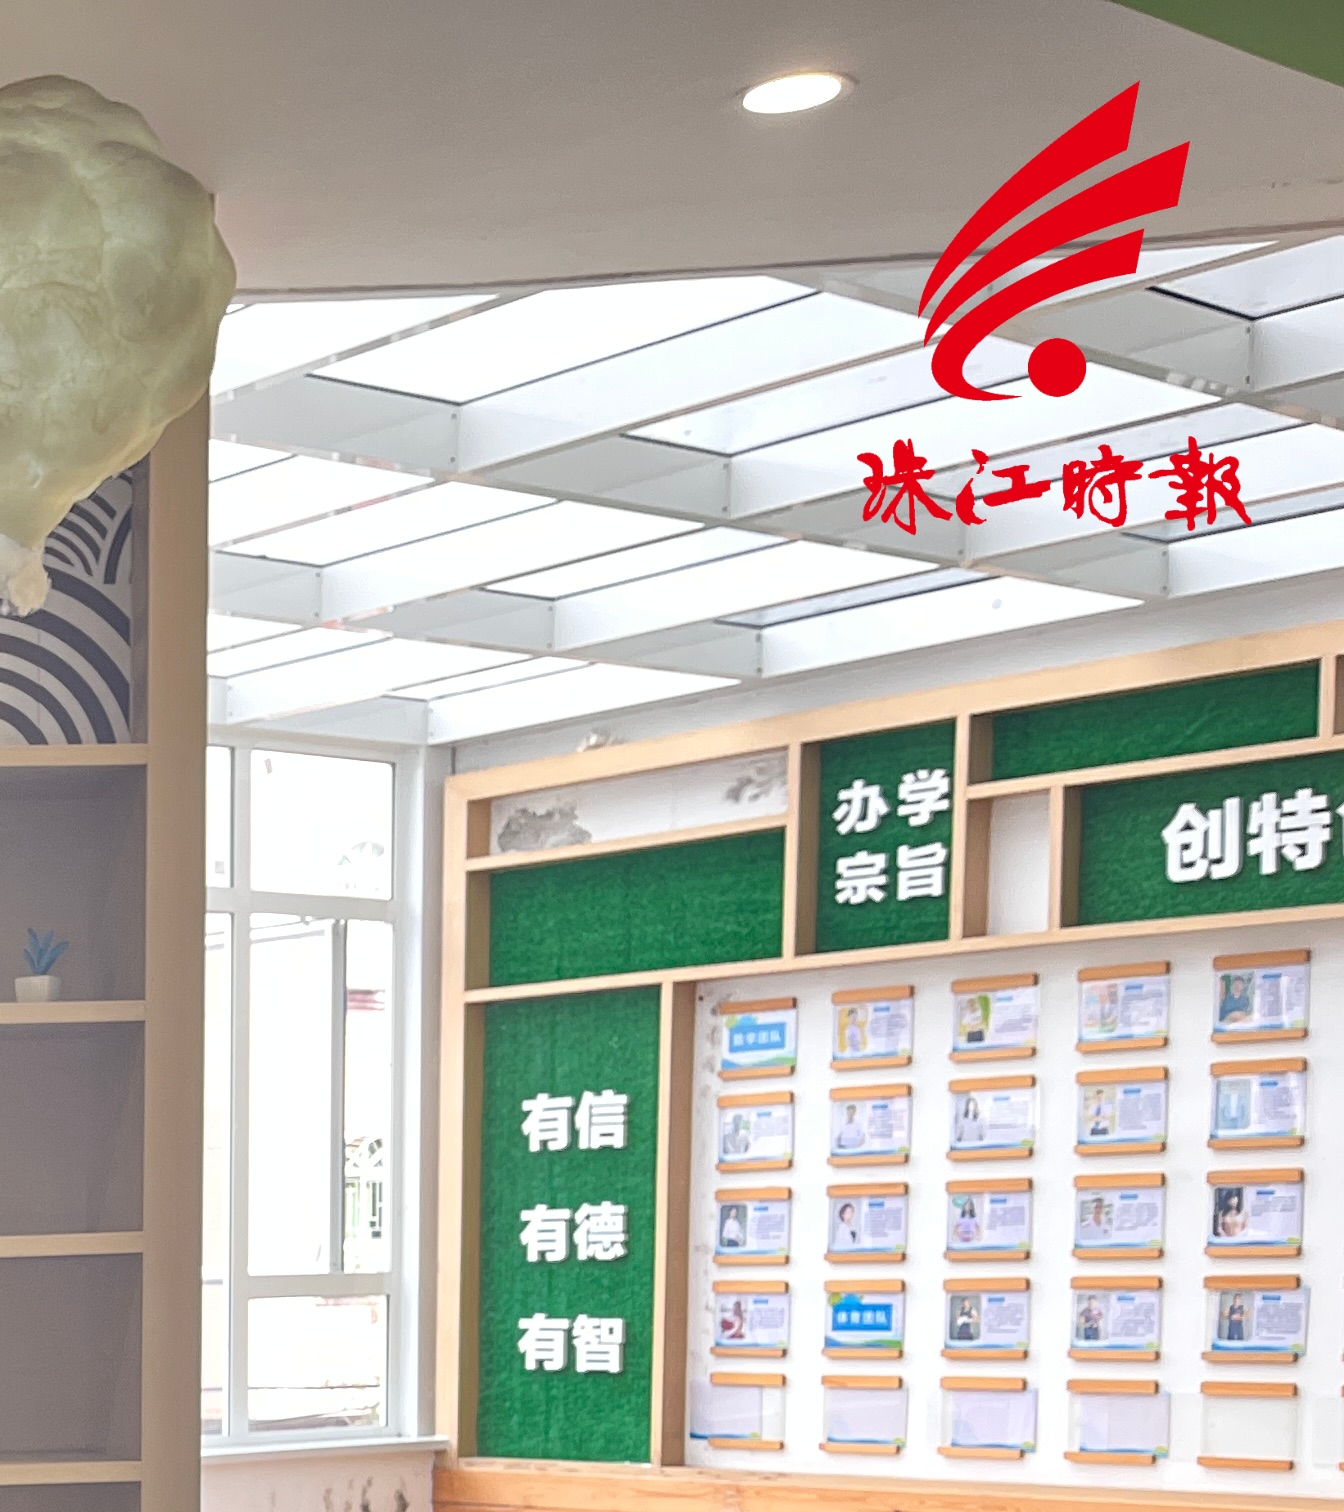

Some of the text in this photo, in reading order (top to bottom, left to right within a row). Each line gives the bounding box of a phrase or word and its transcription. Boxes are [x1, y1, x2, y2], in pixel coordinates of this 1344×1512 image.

[832, 767, 952, 836] 办学
[1161, 787, 1344, 884] 创特
[833, 843, 949, 907] 宗旨
[520, 1089, 629, 1152] 有信
[518, 1200, 629, 1263] 有德
[517, 1313, 626, 1375] 有智
